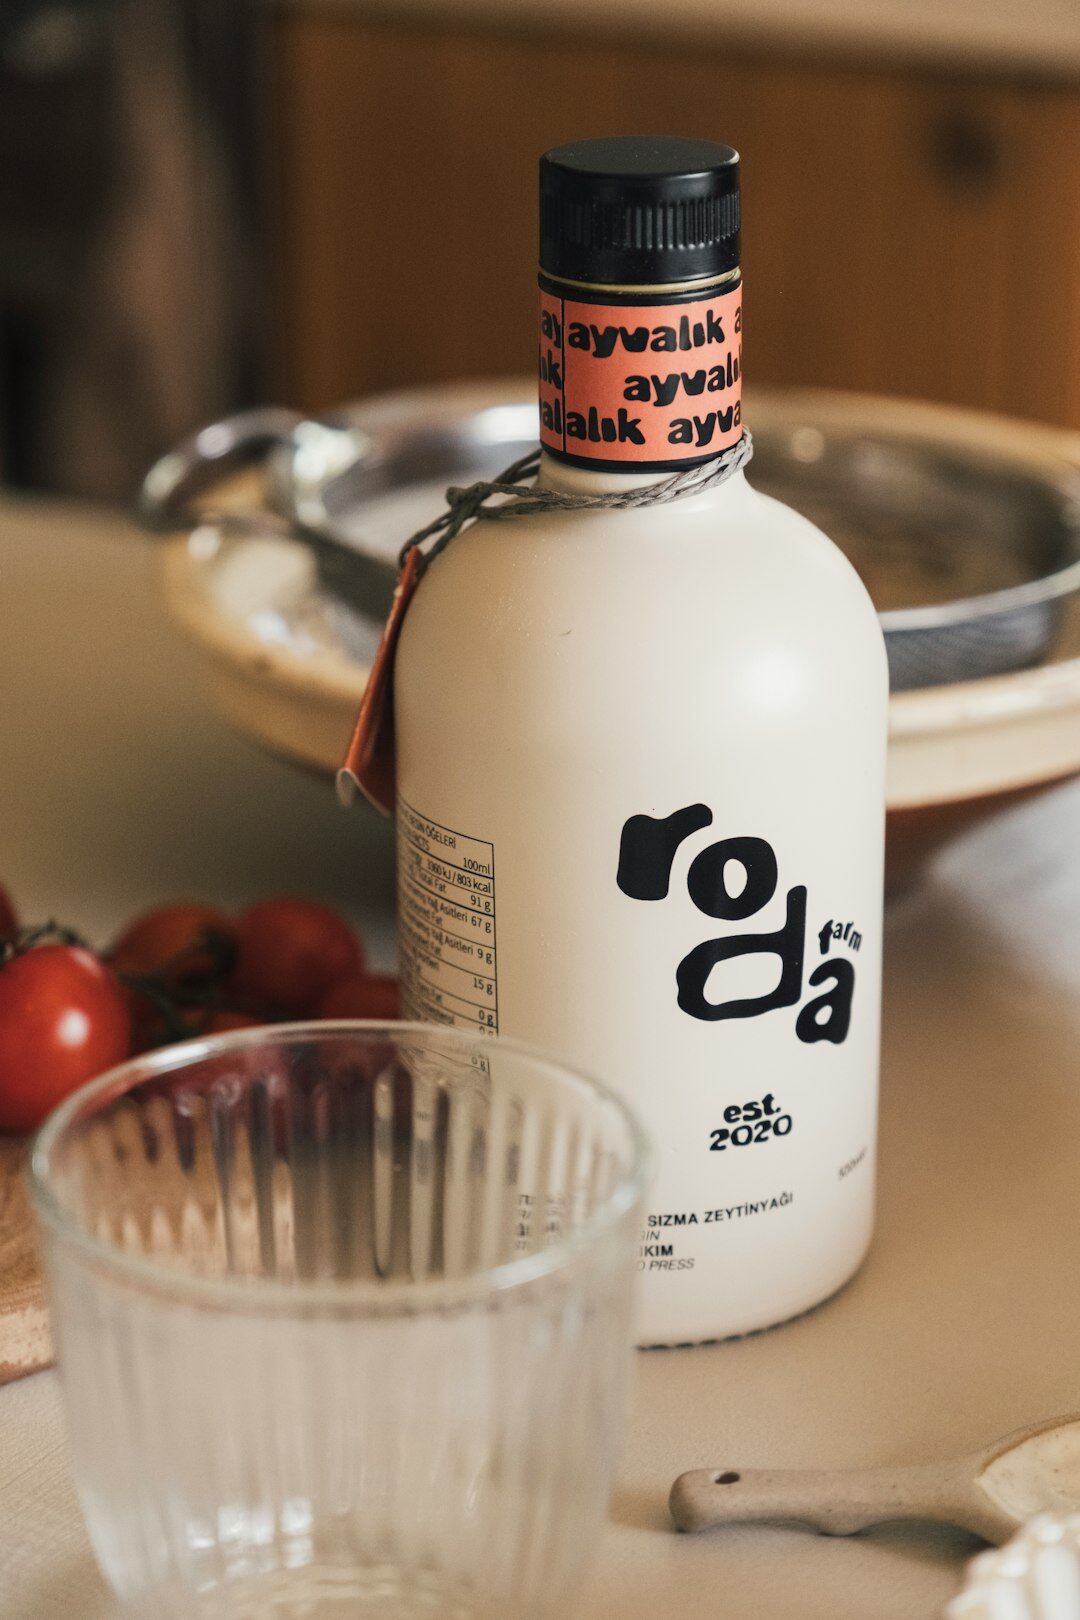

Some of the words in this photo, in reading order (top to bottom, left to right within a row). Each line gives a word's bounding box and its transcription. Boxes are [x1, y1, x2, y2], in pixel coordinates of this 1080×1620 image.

[568, 309, 725, 358] ayvalık
[566, 406, 646, 445] alık
[463, 857, 491, 875] 100ml
[457, 873, 472, 888] 803
[473, 879, 491, 894] kcal
[617, 803, 855, 1045] roda
[819, 919, 862, 955] farm
[444, 936, 474, 955] Asitleri
[477, 948, 483, 959] 9
[473, 977, 484, 990] 15
[723, 1093, 781, 1124] est.
[709, 1114, 793, 1151] 2020
[648, 1213, 698, 1228] SIZMA
[704, 1191, 793, 1224] ZEYTİNYAĞI
[649, 1258, 695, 1271] PRESS
